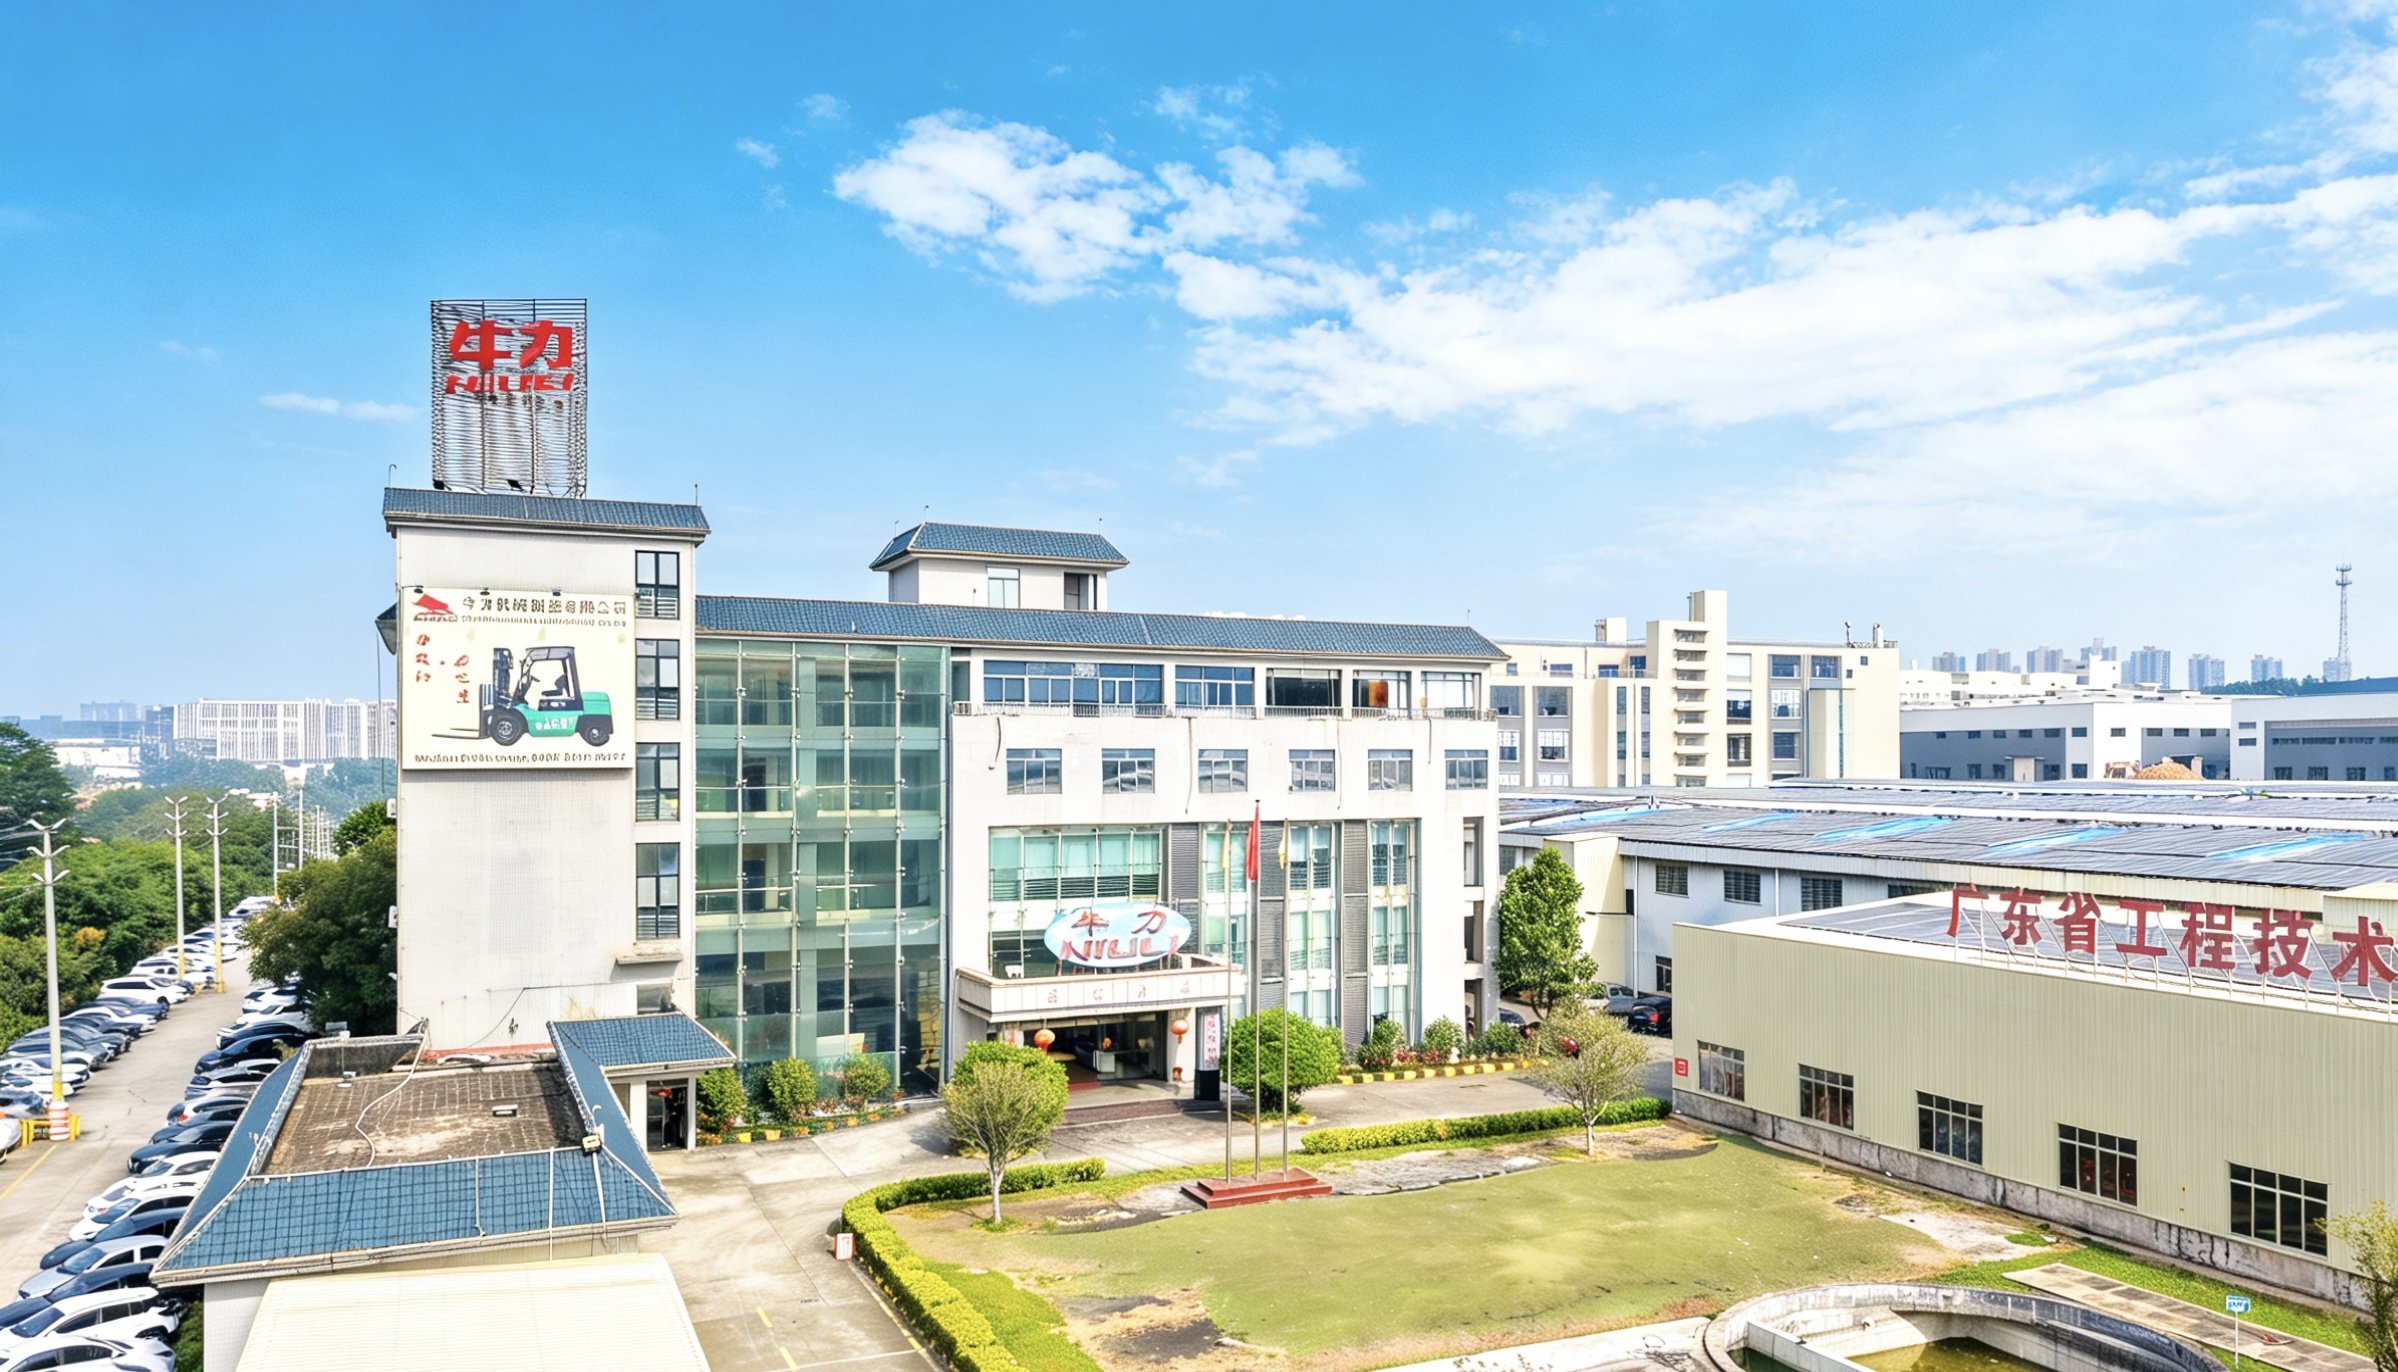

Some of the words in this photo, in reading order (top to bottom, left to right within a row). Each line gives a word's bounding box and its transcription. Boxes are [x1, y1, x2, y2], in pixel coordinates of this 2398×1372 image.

[449, 319, 573, 371] 牛力
[1071, 910, 1167, 937] 牛力
[1947, 883, 2397, 987] 广东省工程技术
[1058, 935, 1179, 962] NIULI
